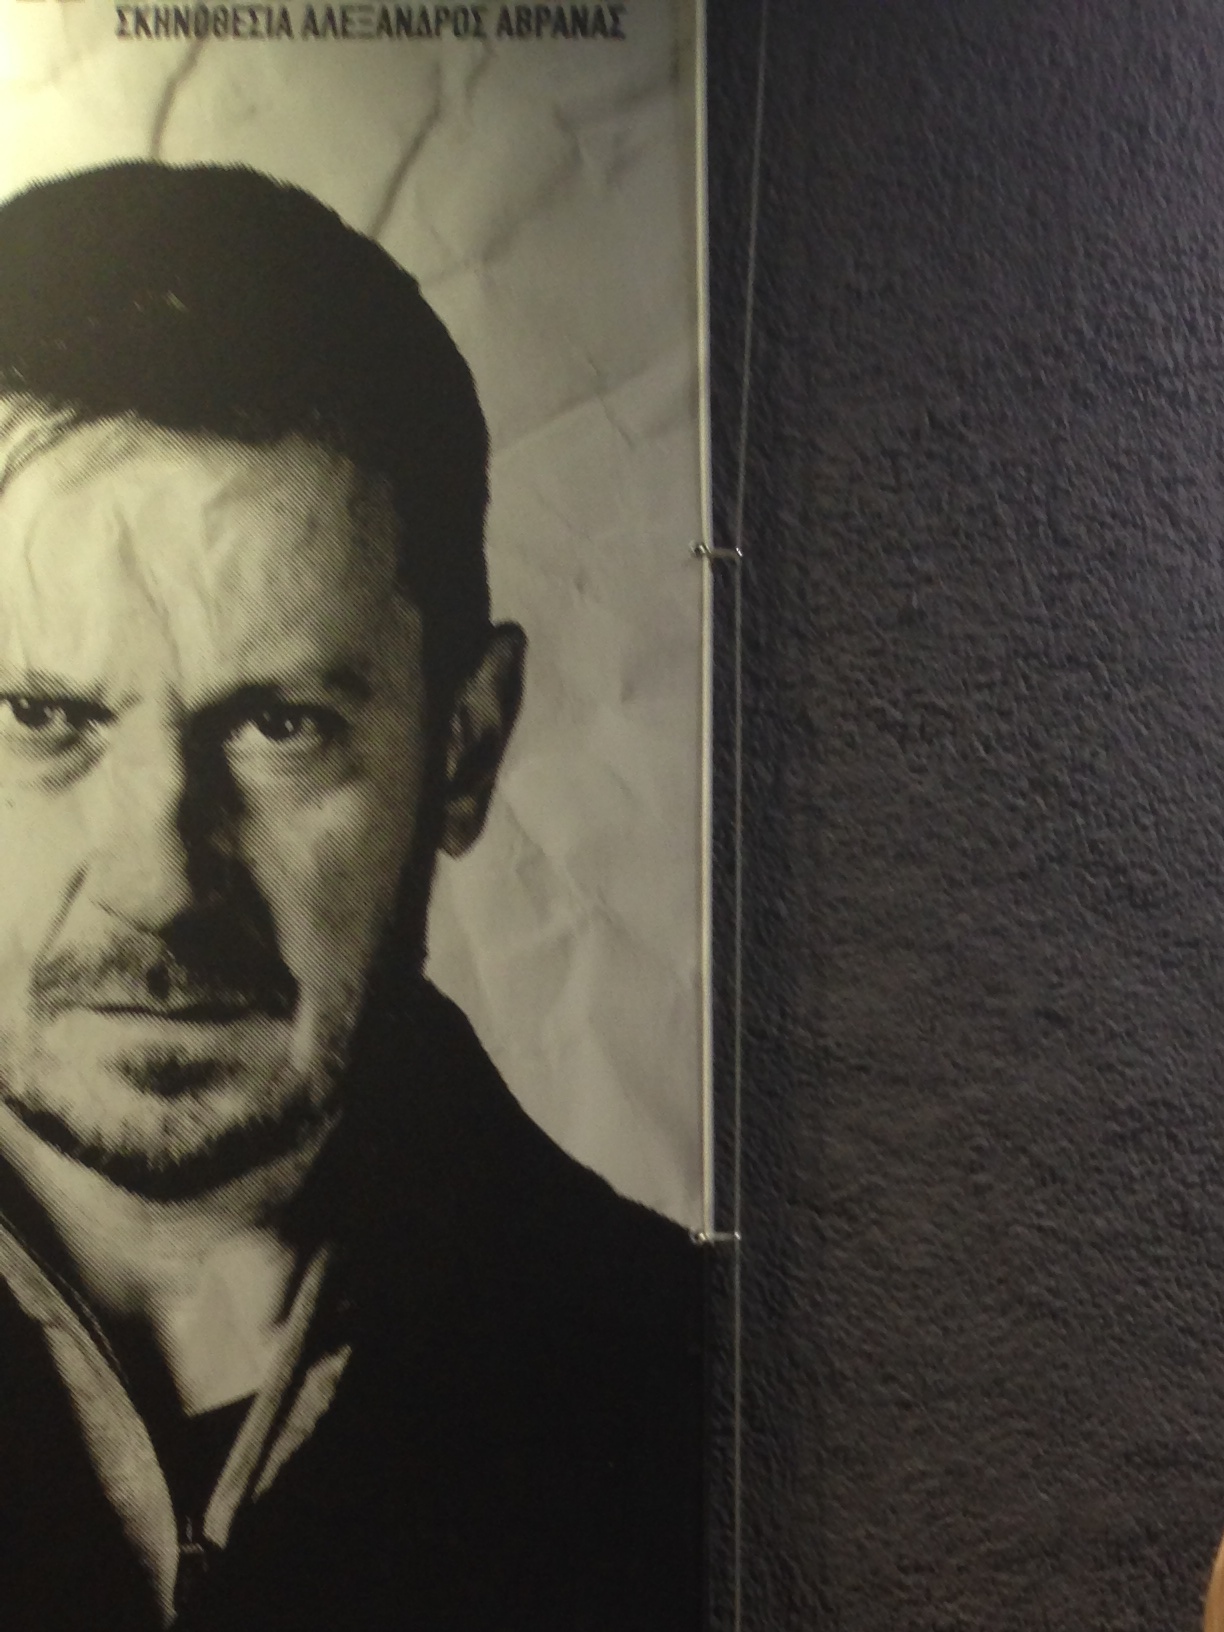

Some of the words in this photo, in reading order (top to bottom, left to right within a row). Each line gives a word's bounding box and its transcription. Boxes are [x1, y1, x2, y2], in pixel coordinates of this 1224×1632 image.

[115, 5, 294, 38] ΣΚΗΝΟΘΕΣΙΑ
[302, 5, 486, 38] ΑΛΕΞΑΝΔΡΟΣ
[496, 5, 626, 40] ΑΒΡΑΝΑΣ
